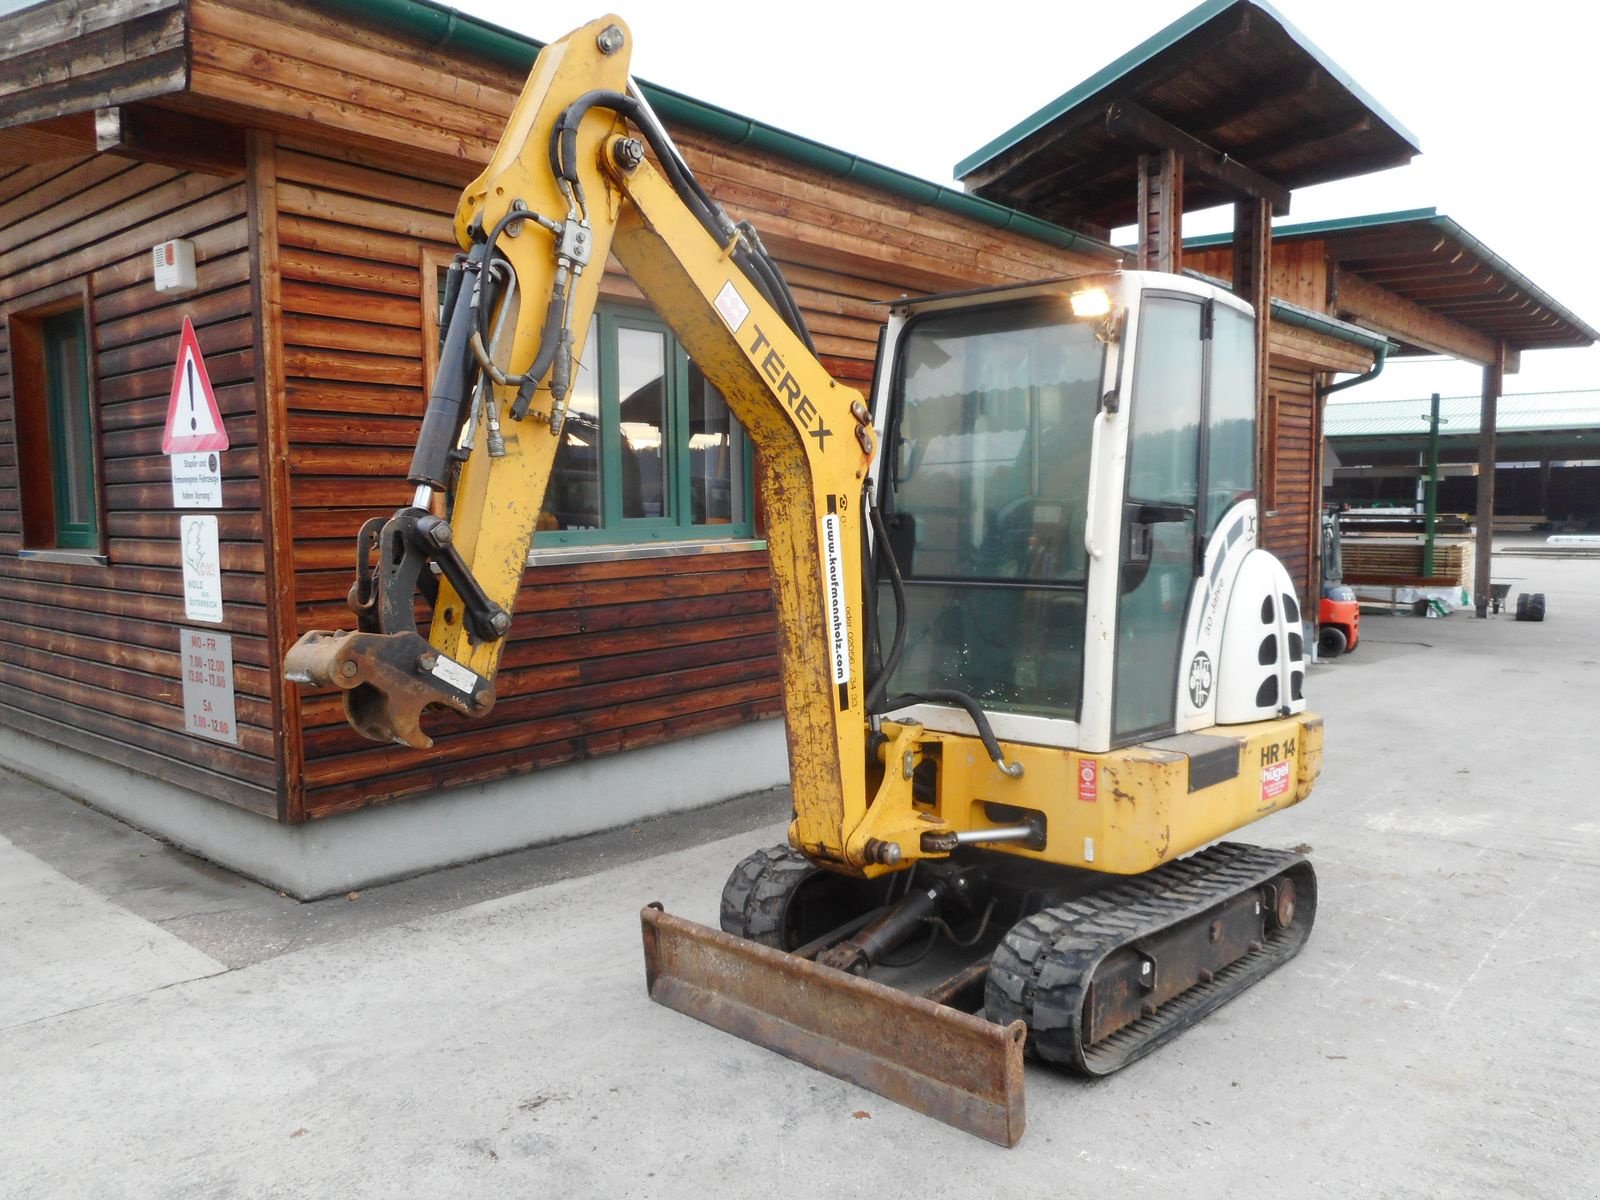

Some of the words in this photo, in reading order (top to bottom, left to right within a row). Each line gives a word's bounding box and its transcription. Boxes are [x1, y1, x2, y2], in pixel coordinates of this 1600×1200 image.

[750, 324, 834, 454] TEREX
[826, 518, 844, 679] www.kaufmannholz.com
[1260, 743, 1280, 767] HR
[1283, 738, 1296, 759] 14
